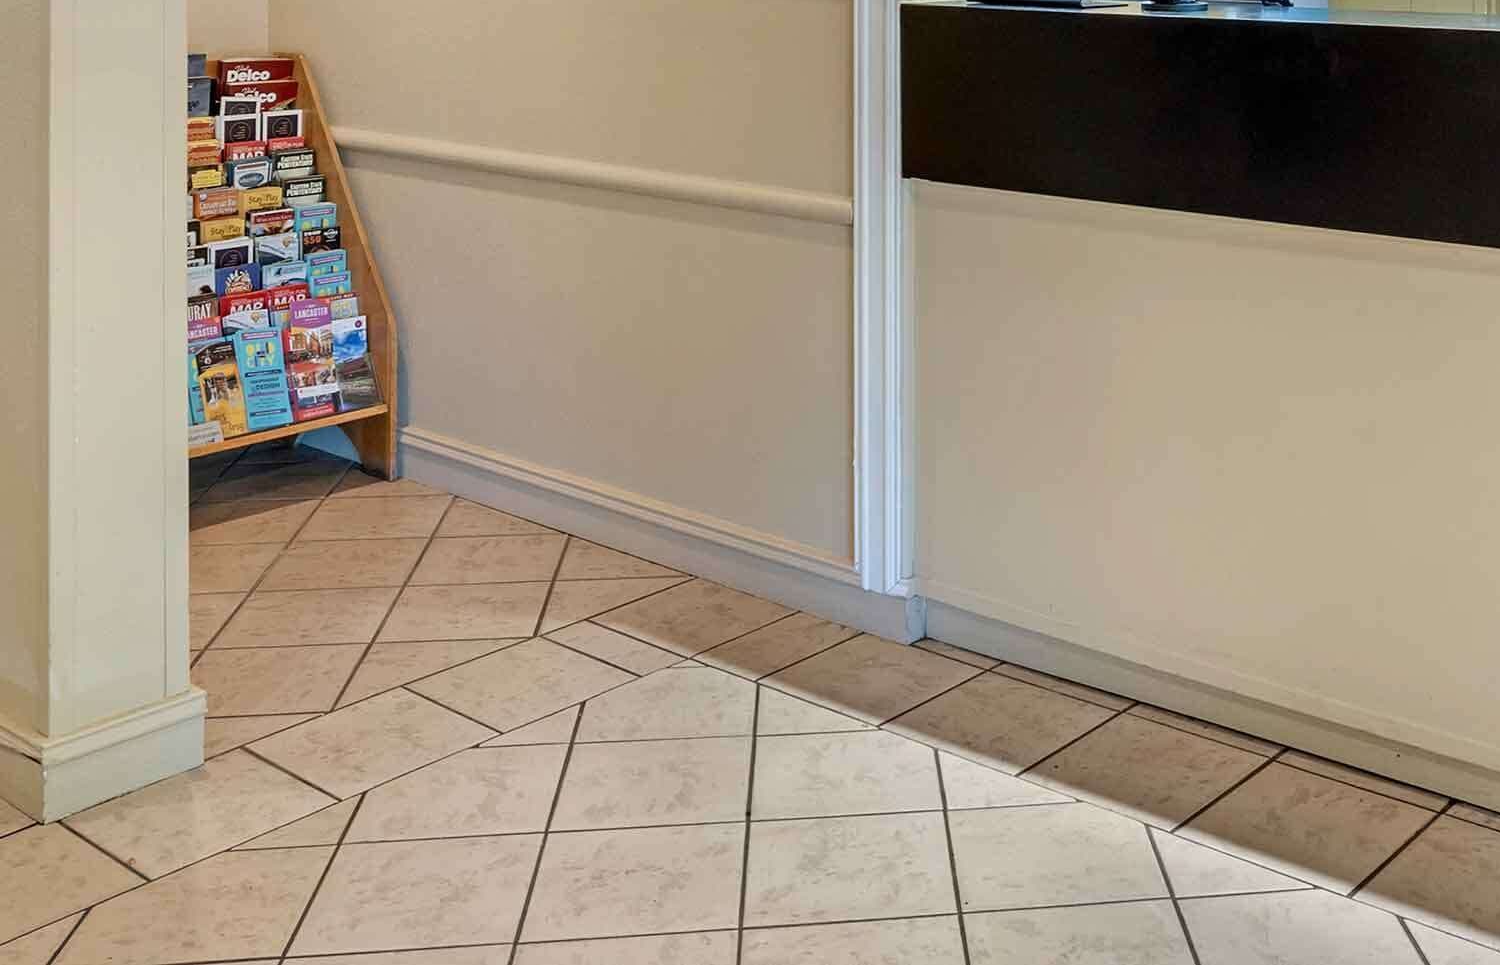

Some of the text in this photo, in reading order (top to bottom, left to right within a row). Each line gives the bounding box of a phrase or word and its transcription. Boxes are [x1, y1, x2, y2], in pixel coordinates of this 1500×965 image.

[227, 69, 271, 83] Delco
[274, 294, 306, 306] MAP
[294, 307, 329, 319] LANCASTER
